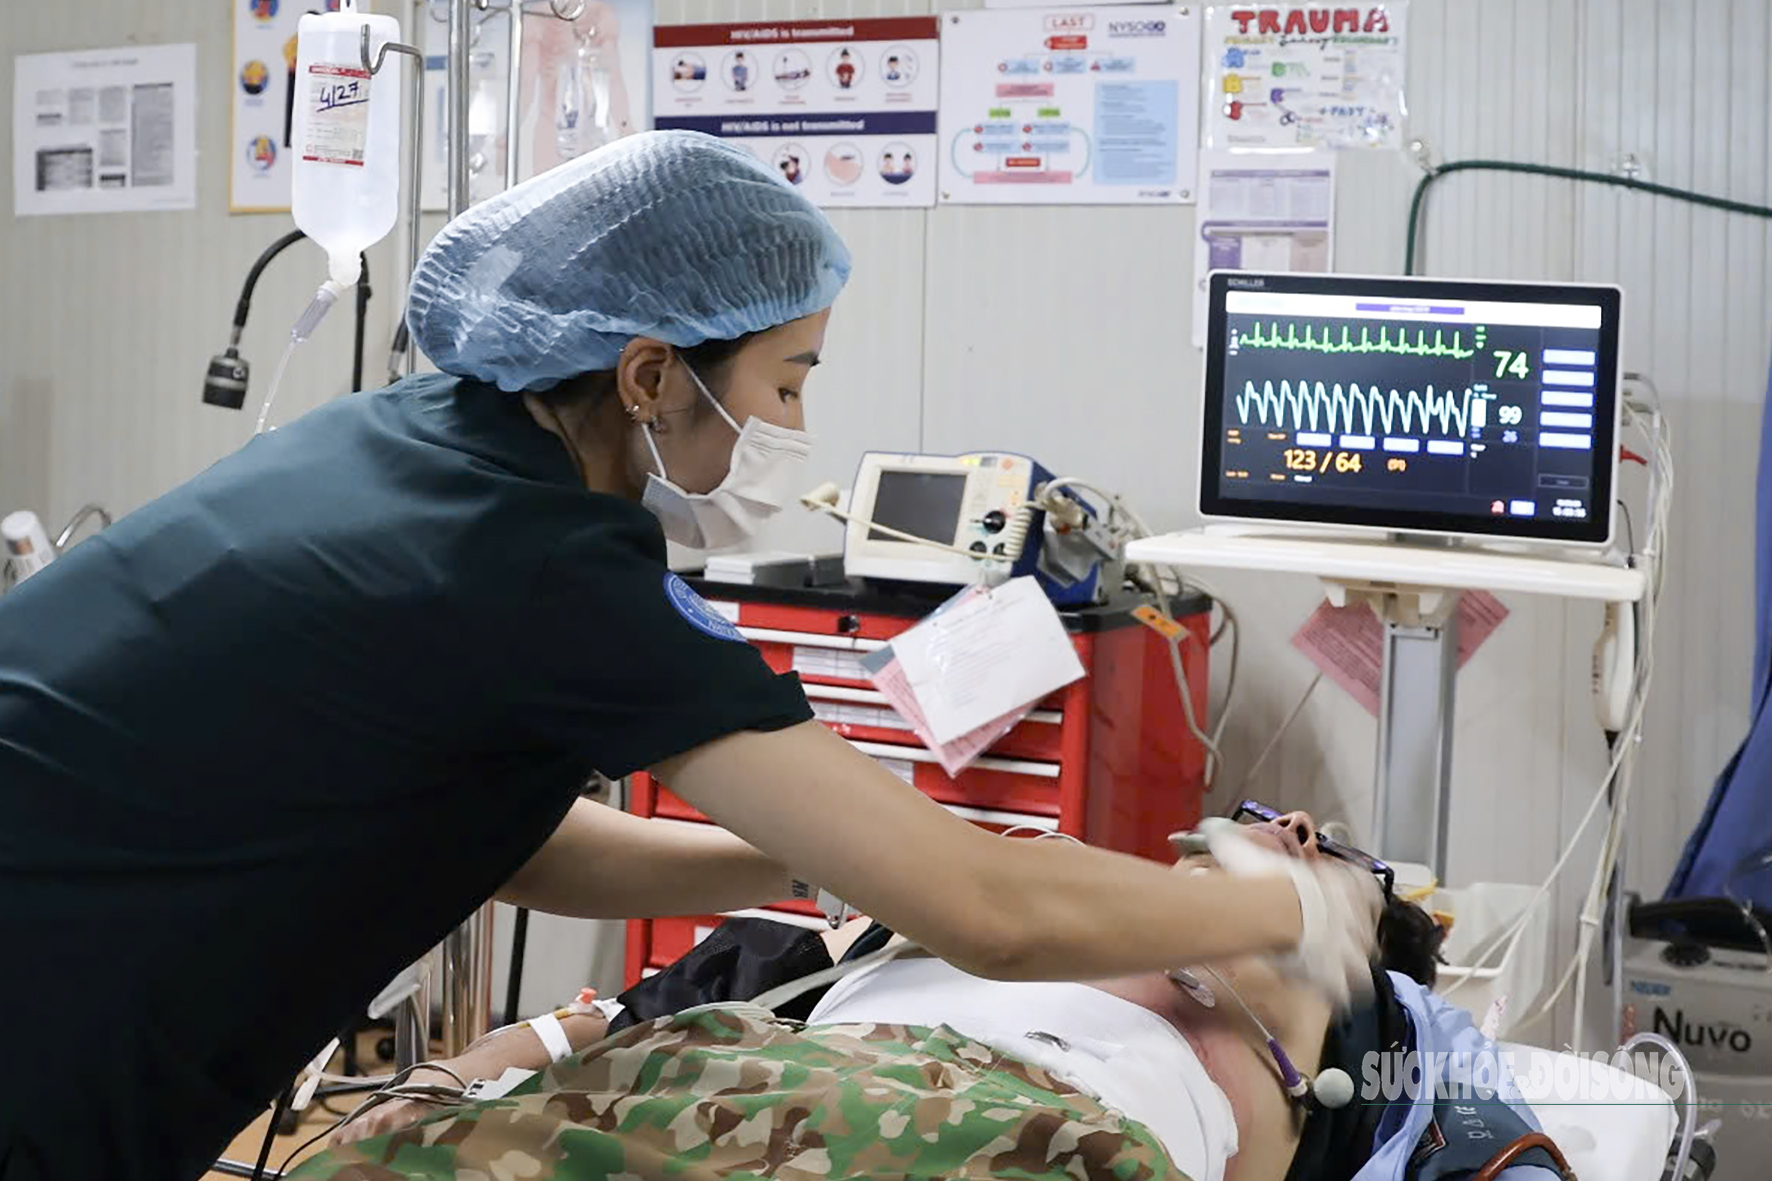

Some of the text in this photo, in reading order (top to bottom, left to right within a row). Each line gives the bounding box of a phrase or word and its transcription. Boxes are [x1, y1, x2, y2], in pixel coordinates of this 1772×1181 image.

[1051, 17, 1084, 28] LAST
[1231, 8, 1389, 34] TRAUMA
[721, 119, 865, 133] HIV/AIDS is not transmitted
[1493, 351, 1529, 379] 74
[1499, 406, 1522, 424] 99
[1283, 449, 1316, 471] 123
[1335, 452, 1361, 473] 64
[1653, 1006, 1752, 1053] Nuvo
